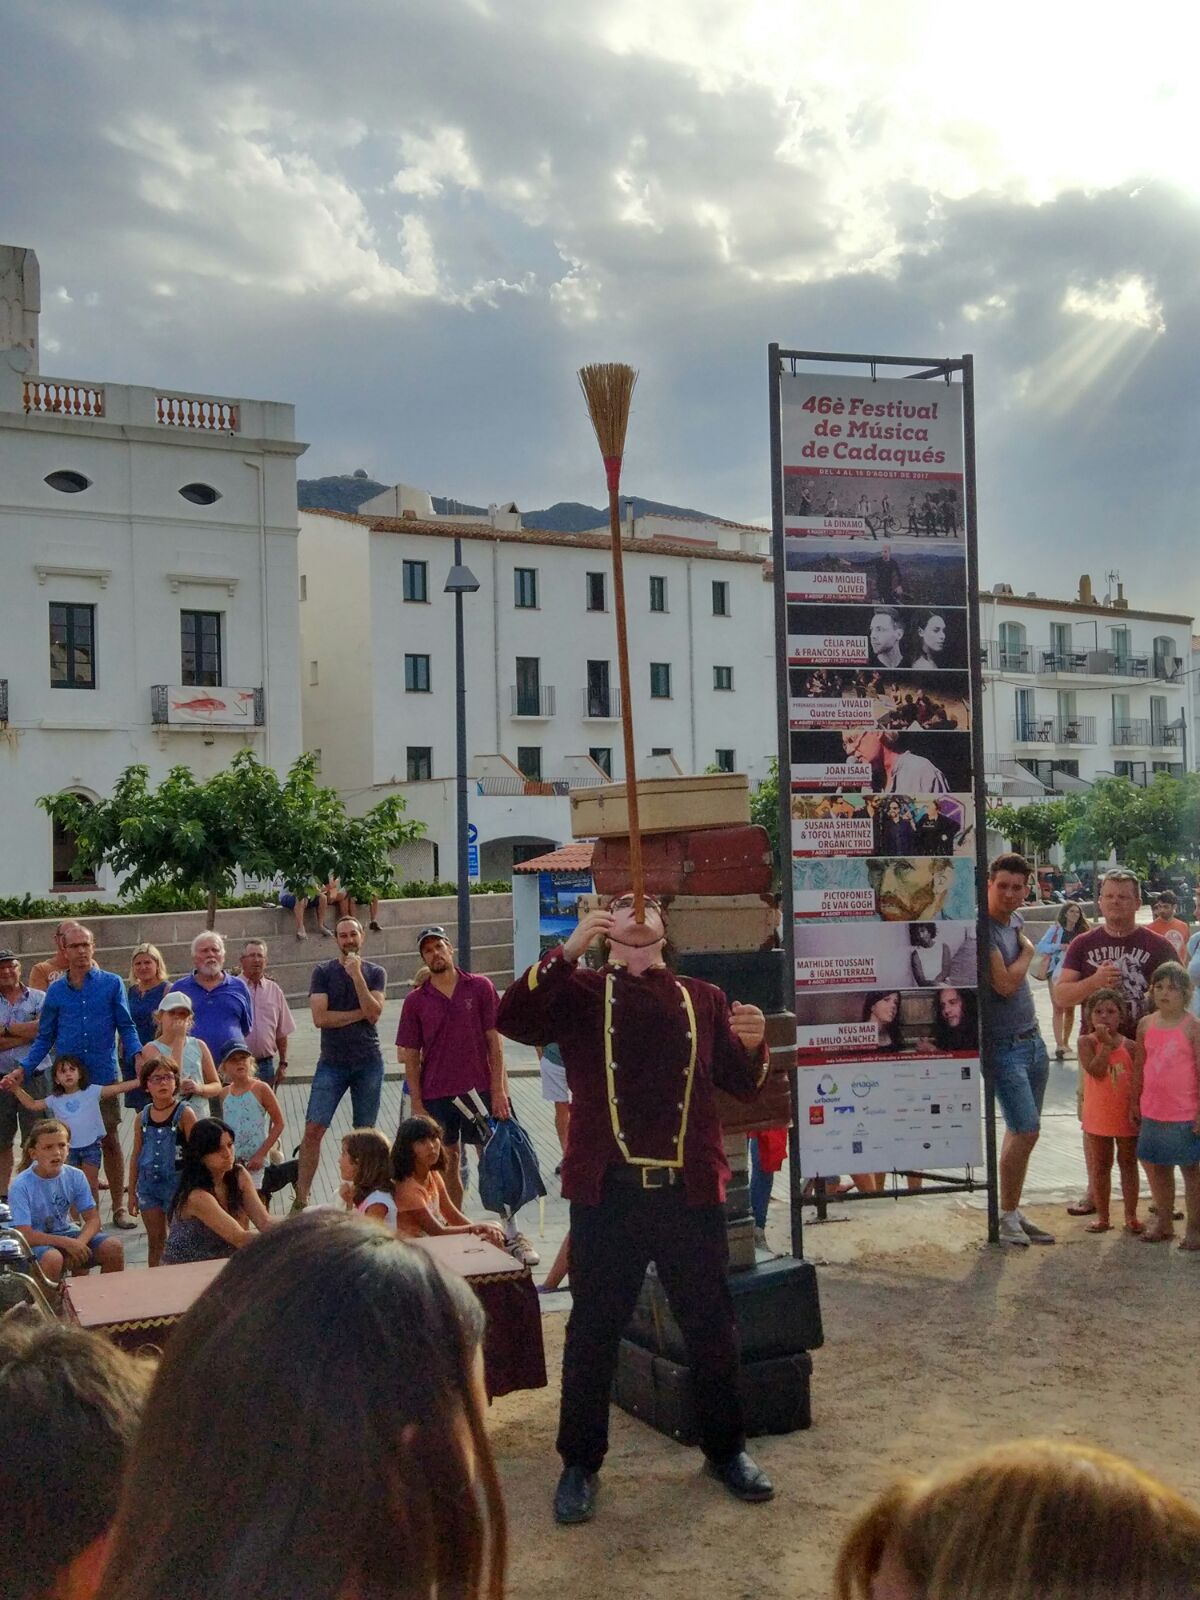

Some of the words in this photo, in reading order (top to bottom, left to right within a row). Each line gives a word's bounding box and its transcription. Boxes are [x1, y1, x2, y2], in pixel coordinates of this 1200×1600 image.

[801, 396, 846, 415] 46è
[848, 398, 938, 420] Festival
[814, 419, 842, 437] de
[847, 420, 929, 442] Música
[801, 441, 830, 459] de
[833, 442, 946, 466] Cadaqués
[866, 470, 897, 478] D'AGOST
[824, 520, 833, 528] LA
[834, 520, 863, 529] DINAMO
[812, 575, 833, 583] JOAN
[835, 575, 865, 584] MIQUEL
[837, 584, 865, 594] OLIVER
[795, 648, 800, 656] &
[842, 649, 866, 657] KLARK
[841, 699, 872, 708] VIVALDI
[809, 709, 836, 718] Quatre
[837, 709, 872, 718] Estacions
[825, 766, 846, 775] JOAN
[847, 766, 870, 775] ISAAC
[804, 821, 835, 830] SUSANA
[836, 821, 871, 829] SHEIMAN
[800, 831, 806, 839] &
[808, 830, 832, 839] TOFOL
[818, 840, 852, 848] ORGANIC
[854, 839, 871, 848] TRIO
[824, 891, 873, 900] PICTOFONIES
[821, 901, 831, 910] DE
[833, 901, 849, 909] VAN
[850, 900, 873, 909] GOGH
[797, 960, 834, 969] MATHILDE
[835, 958, 874, 967] TOUSSAINT
[810, 970, 815, 978] &
[817, 969, 842, 977] IGNASI
[843, 967, 874, 976] TERRAZA
[838, 1026, 858, 1034] NEUS
[858, 1025, 876, 1033] MAR
[816, 1037, 841, 1045] EMILIO
